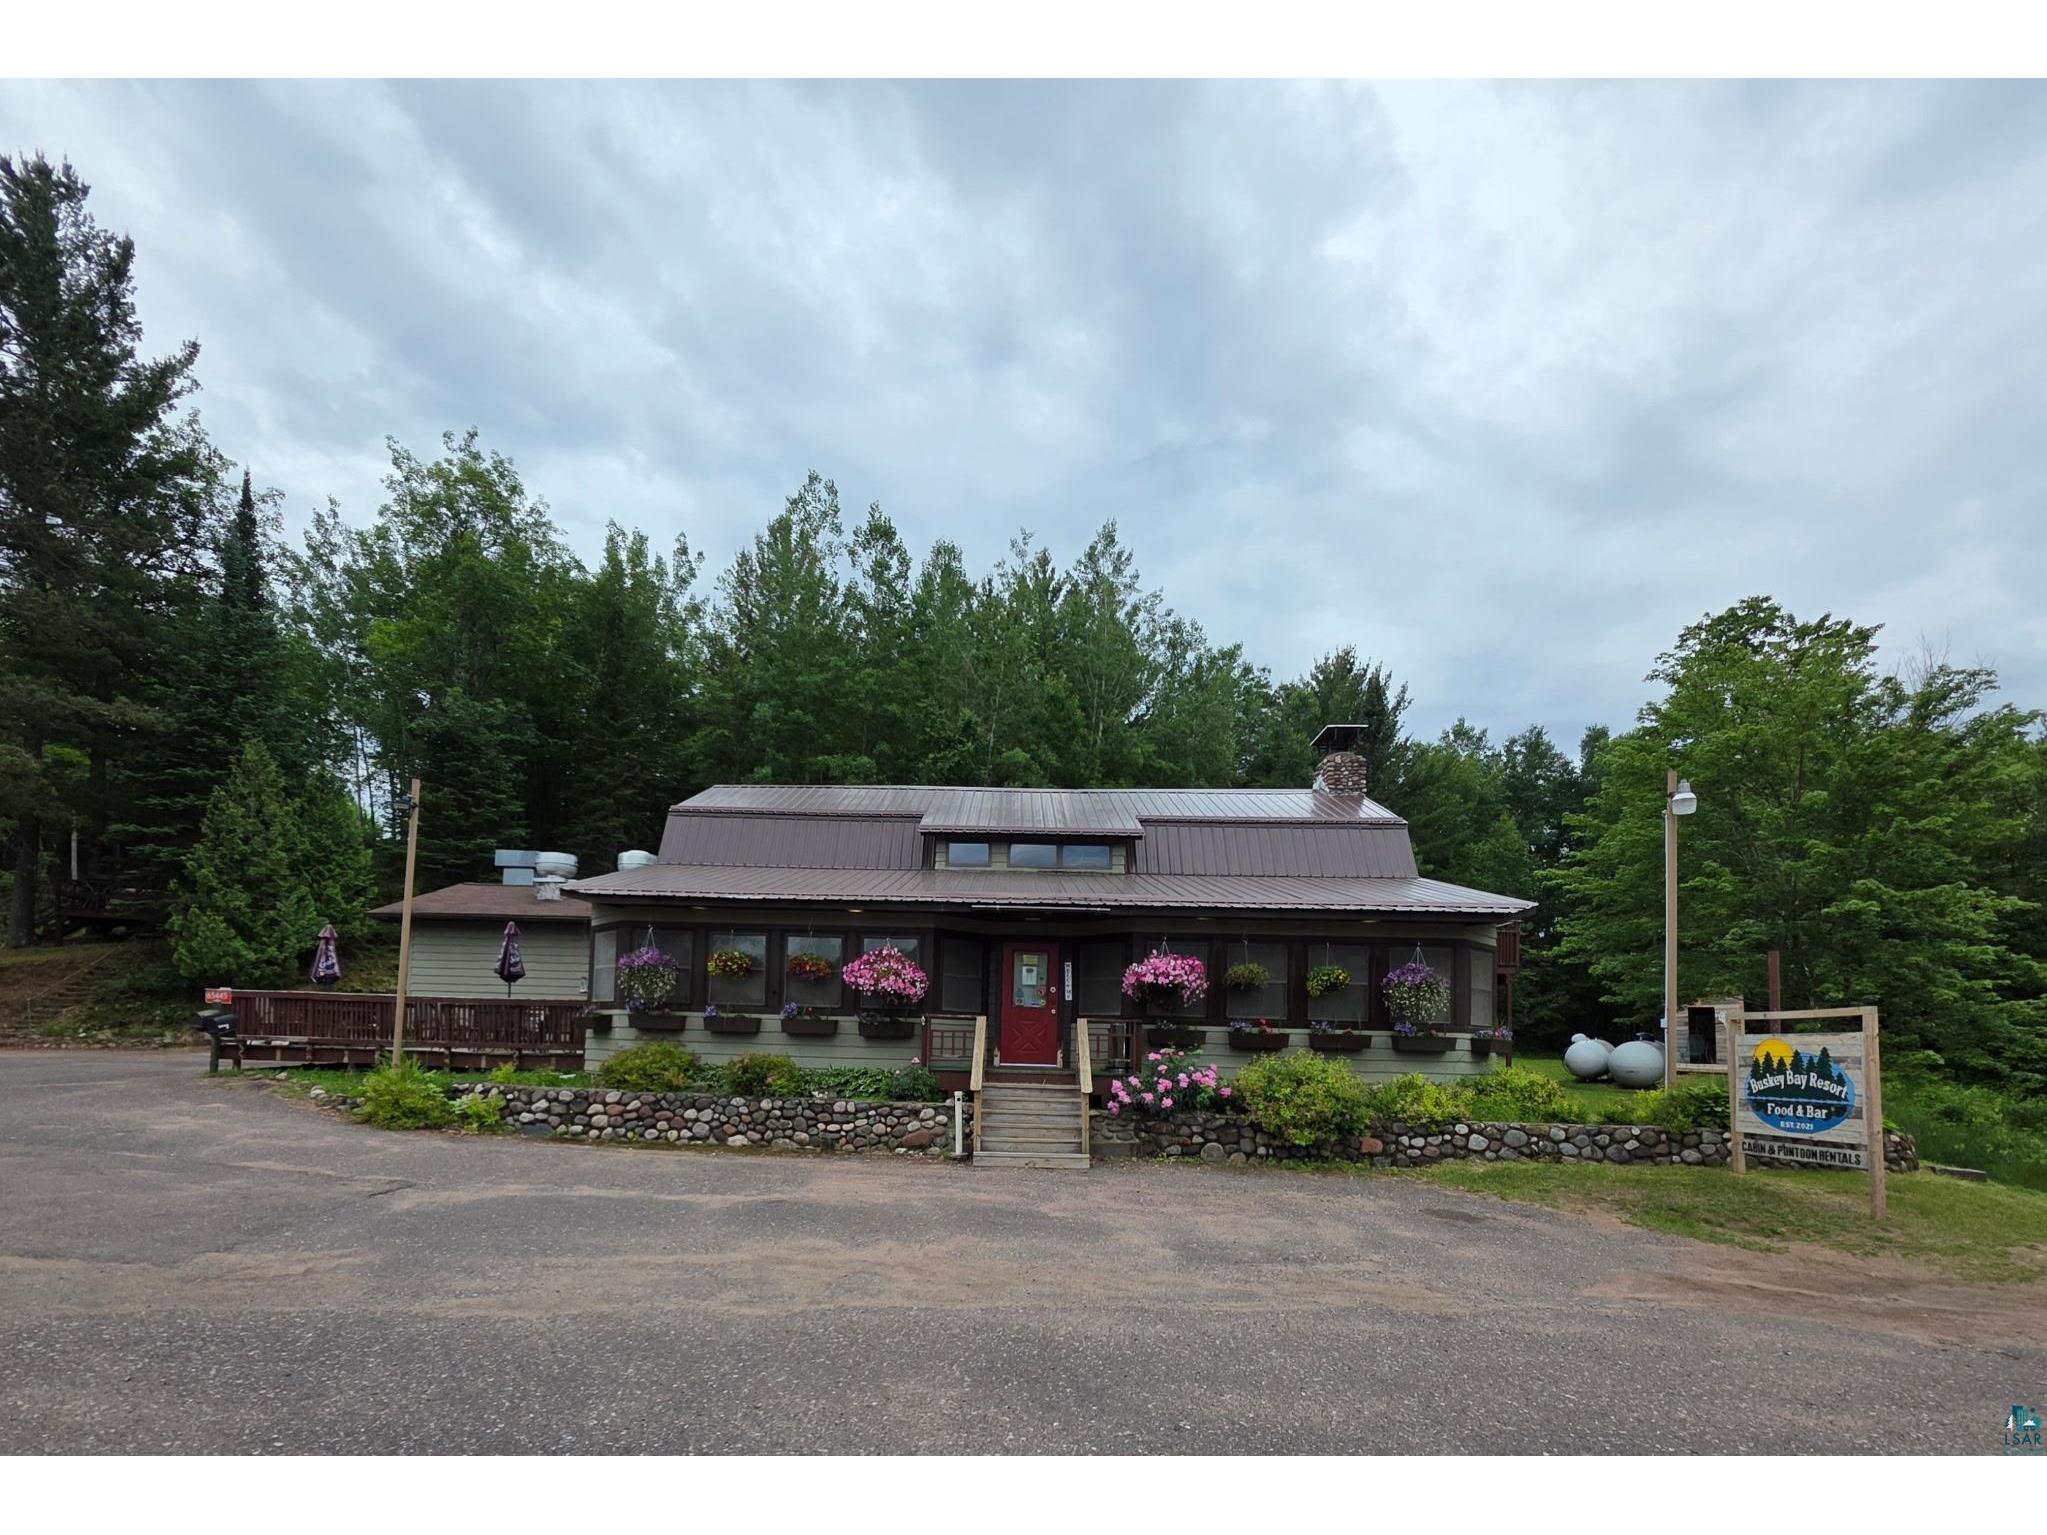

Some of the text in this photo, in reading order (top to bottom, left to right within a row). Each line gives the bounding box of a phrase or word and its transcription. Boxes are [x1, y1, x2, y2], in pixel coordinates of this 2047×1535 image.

[1749, 1069, 1848, 1099] Buskey Bay Resort
[1767, 1103, 1829, 1119] Food & Bar
[1741, 1141, 1861, 1166] CABIN & PONTOON RENTALS
